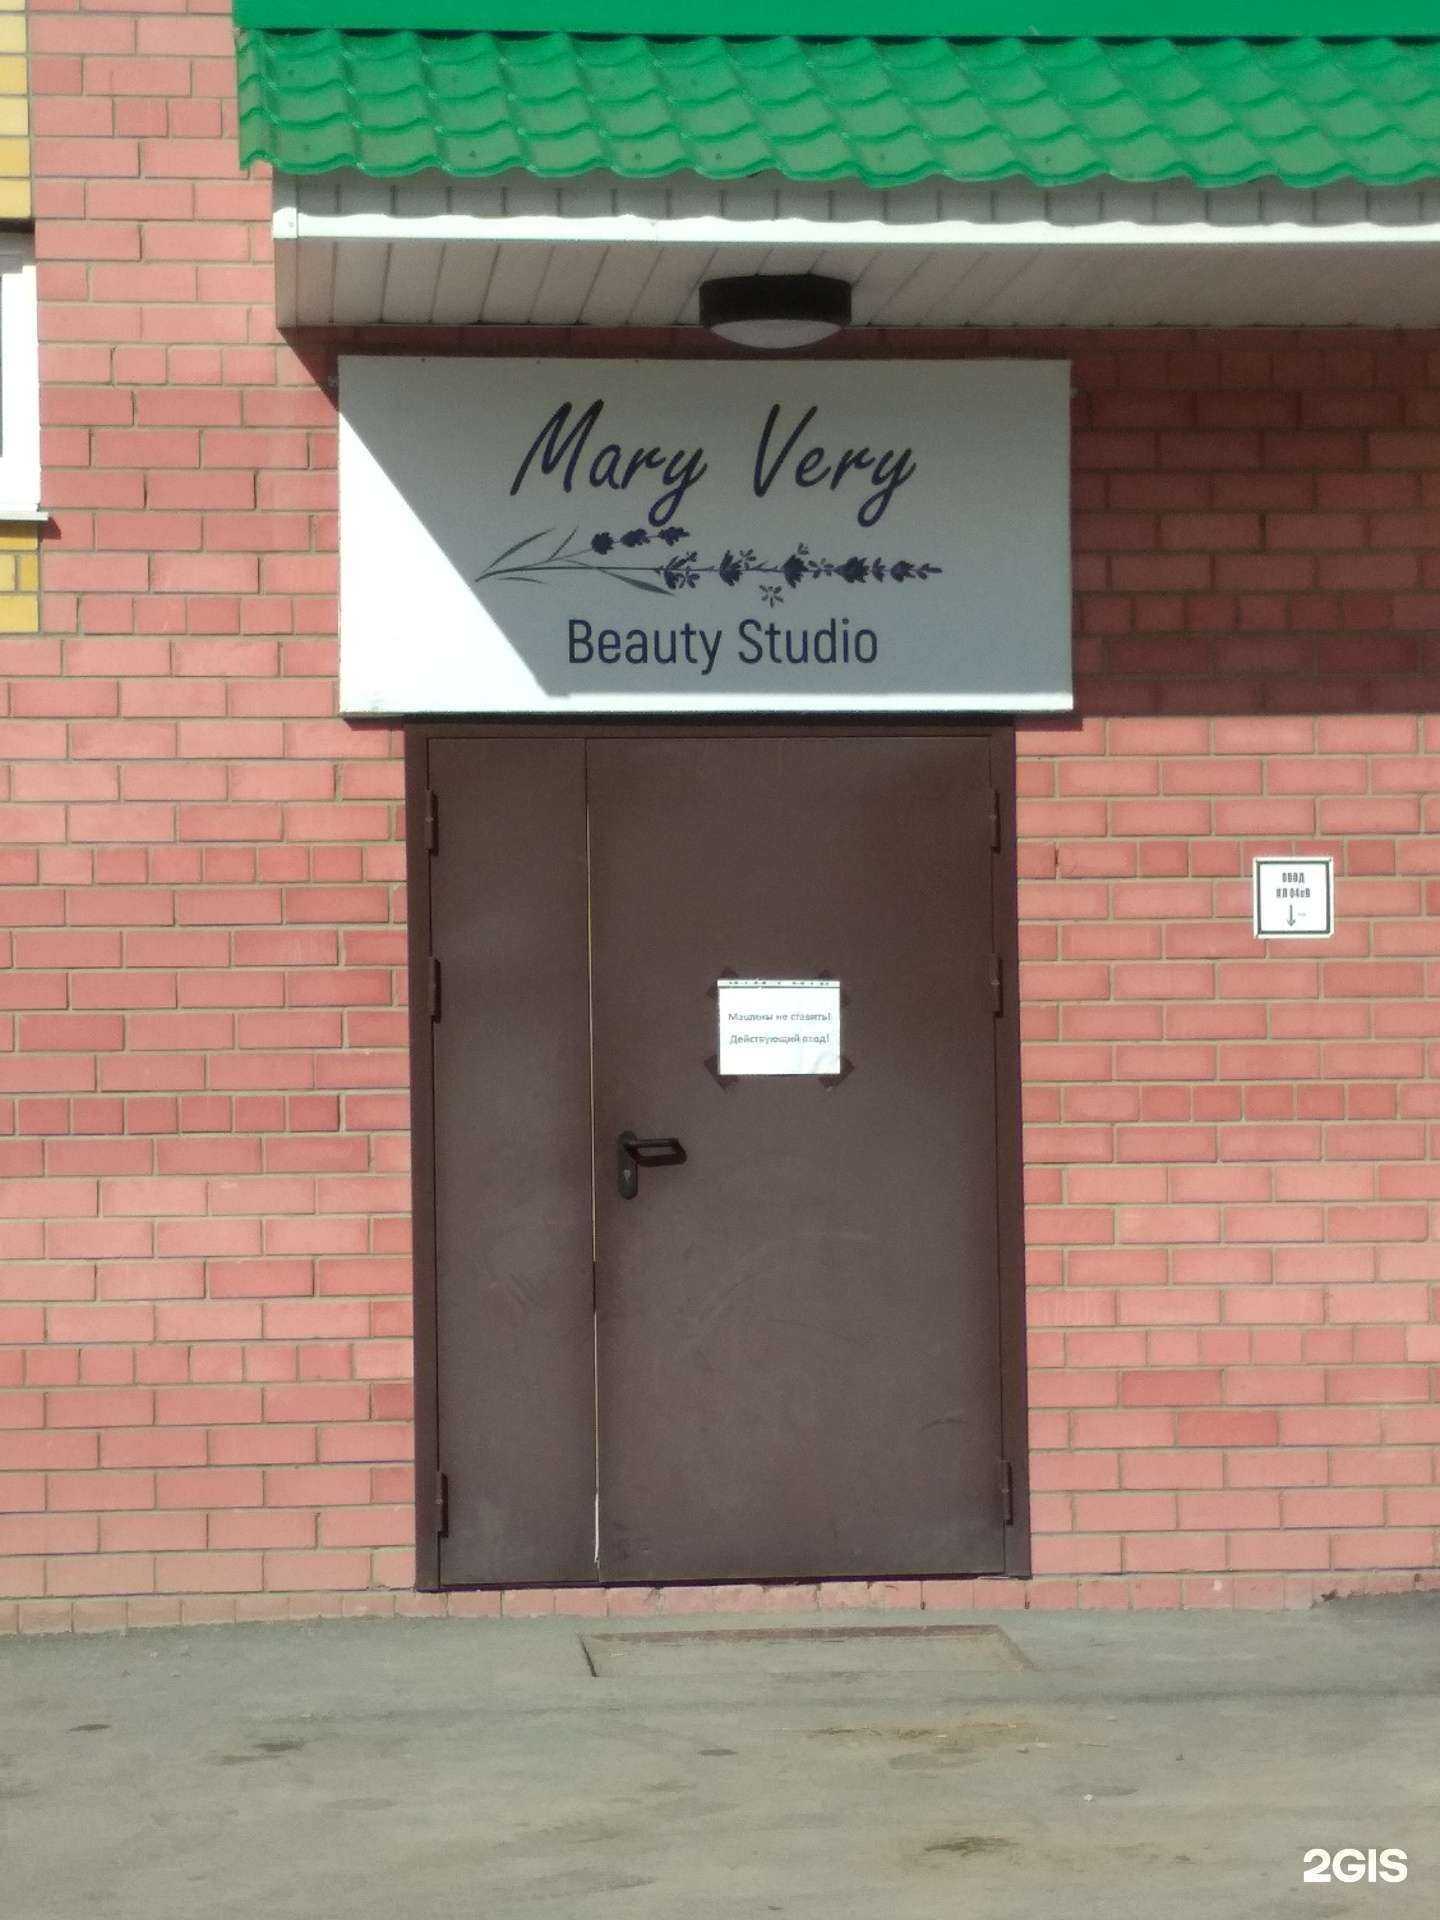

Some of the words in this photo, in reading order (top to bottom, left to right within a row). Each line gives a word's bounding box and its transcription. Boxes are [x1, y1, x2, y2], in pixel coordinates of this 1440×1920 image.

[510, 399, 707, 527] Mary
[752, 403, 916, 527] Very
[568, 619, 722, 675] Beauty
[738, 618, 878, 665] Studio
